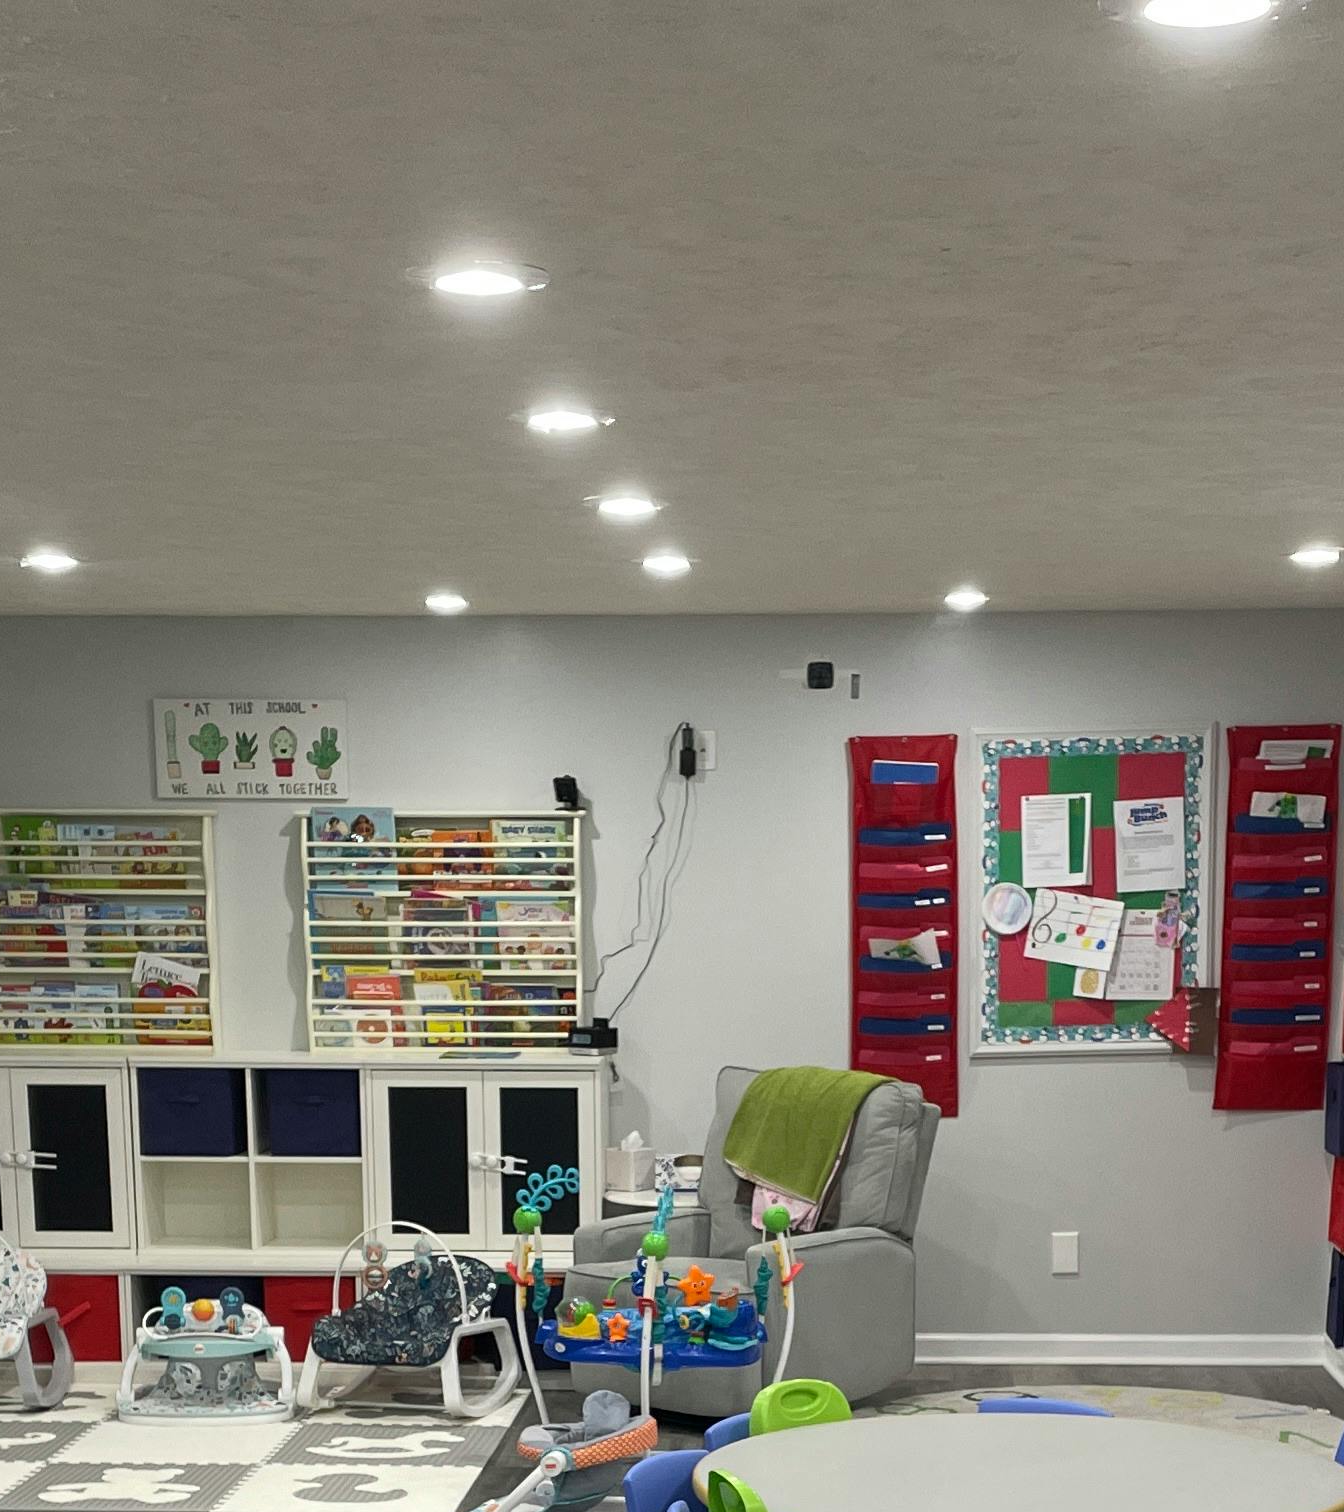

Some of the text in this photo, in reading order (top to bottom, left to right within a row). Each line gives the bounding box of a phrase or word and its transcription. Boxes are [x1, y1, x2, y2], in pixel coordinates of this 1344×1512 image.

[194, 702, 307, 717] AT THIS SCHOOL
[171, 783, 338, 796] WE ALL STICK TOGETHER
